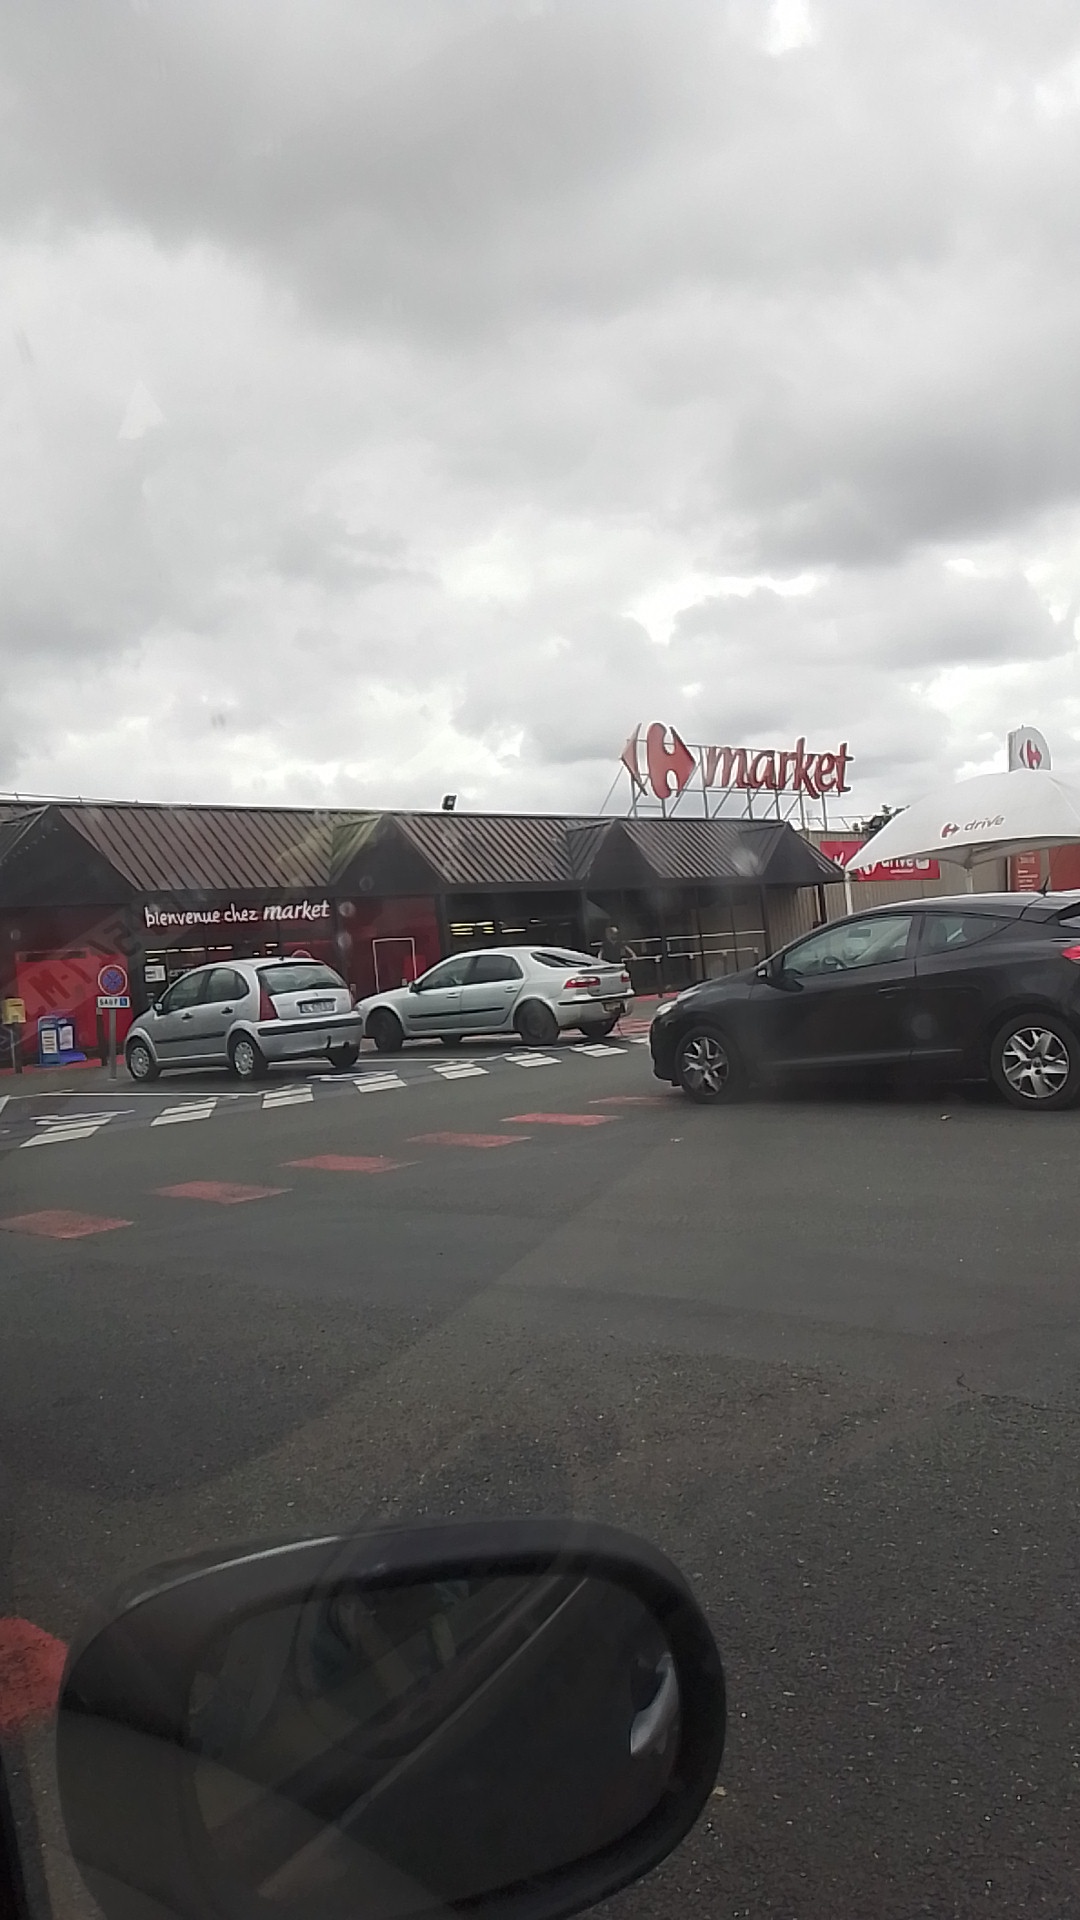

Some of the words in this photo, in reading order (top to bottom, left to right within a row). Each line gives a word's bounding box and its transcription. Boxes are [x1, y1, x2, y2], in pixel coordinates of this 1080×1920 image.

[704, 737, 854, 799] market
[964, 814, 1005, 831] drive
[144, 906, 220, 927] bienvenue
[224, 903, 259, 921] chez
[263, 899, 331, 920] market
